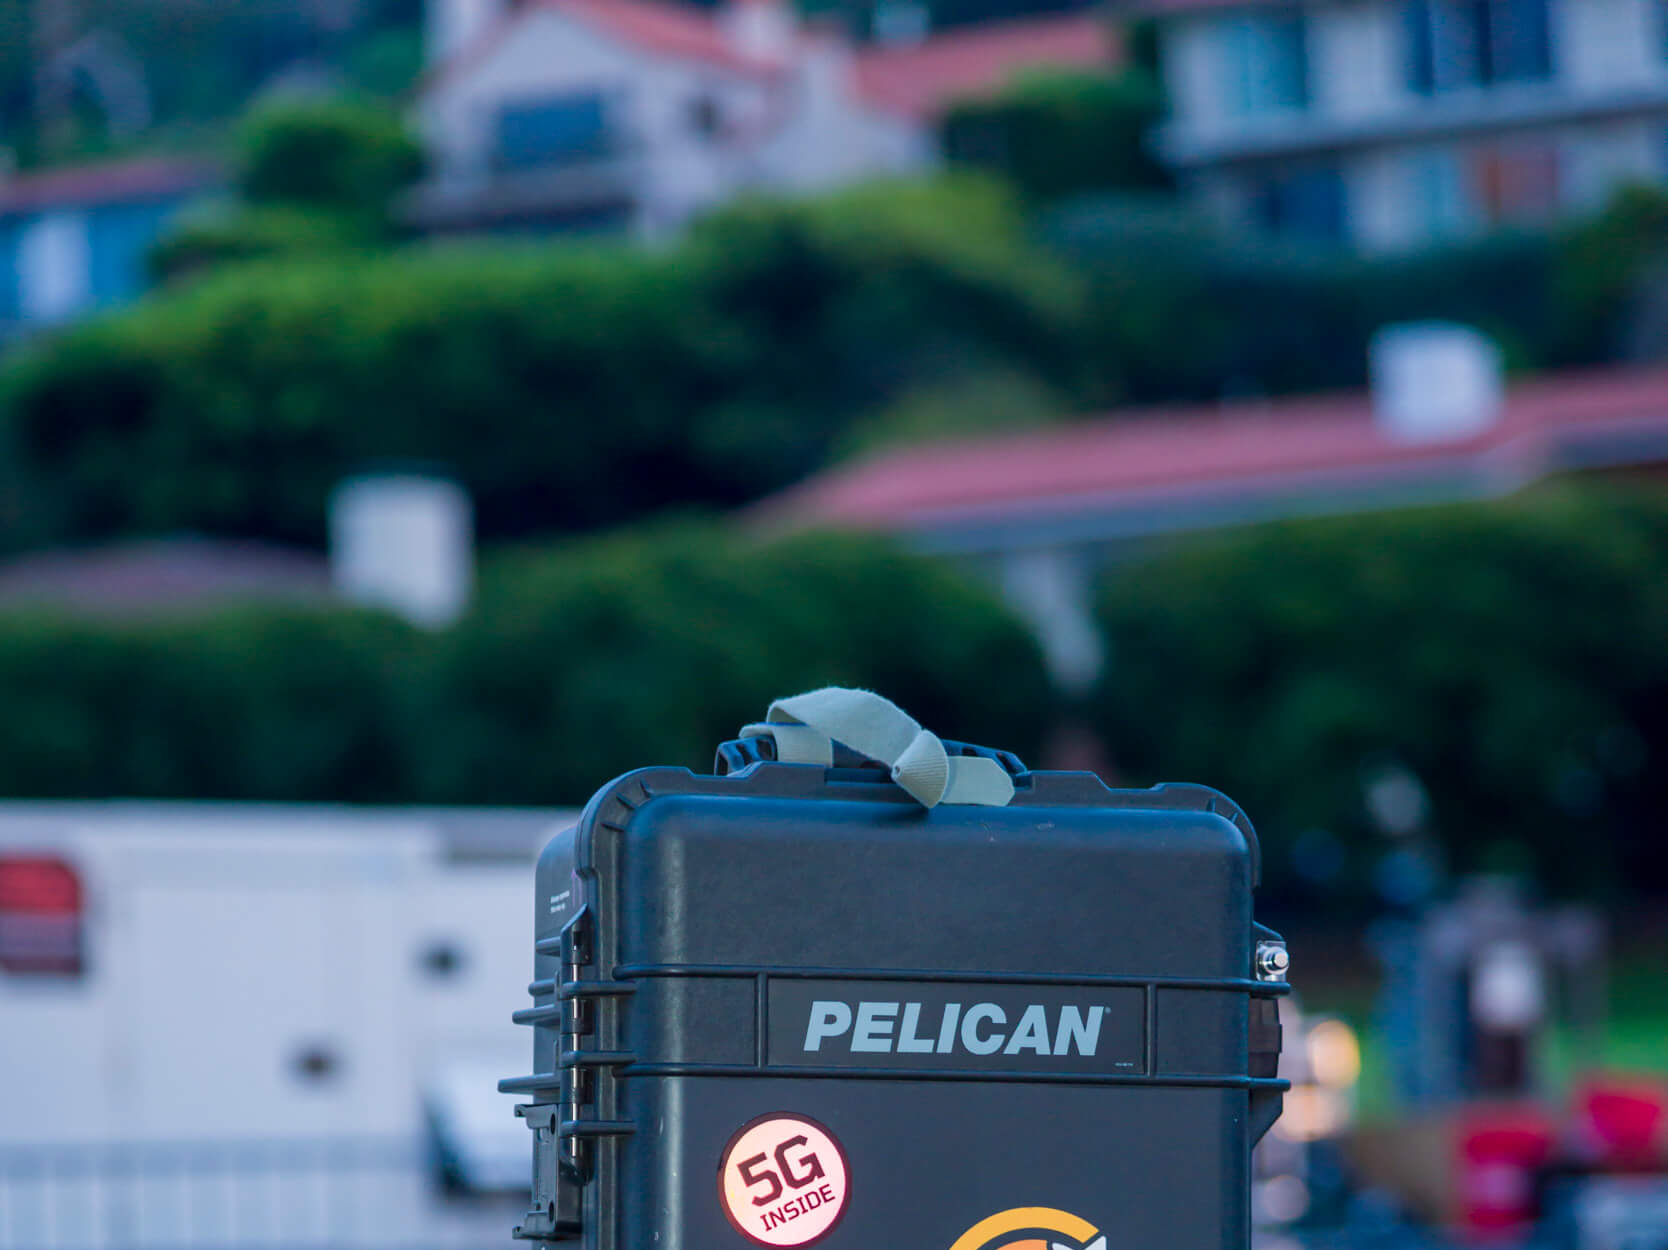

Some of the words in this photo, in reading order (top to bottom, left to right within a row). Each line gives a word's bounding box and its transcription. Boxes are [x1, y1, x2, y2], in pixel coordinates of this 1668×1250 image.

[803, 1001, 1104, 1056] PELICAN
[736, 1134, 826, 1207] 5G
[760, 1183, 836, 1232] INSIDE
